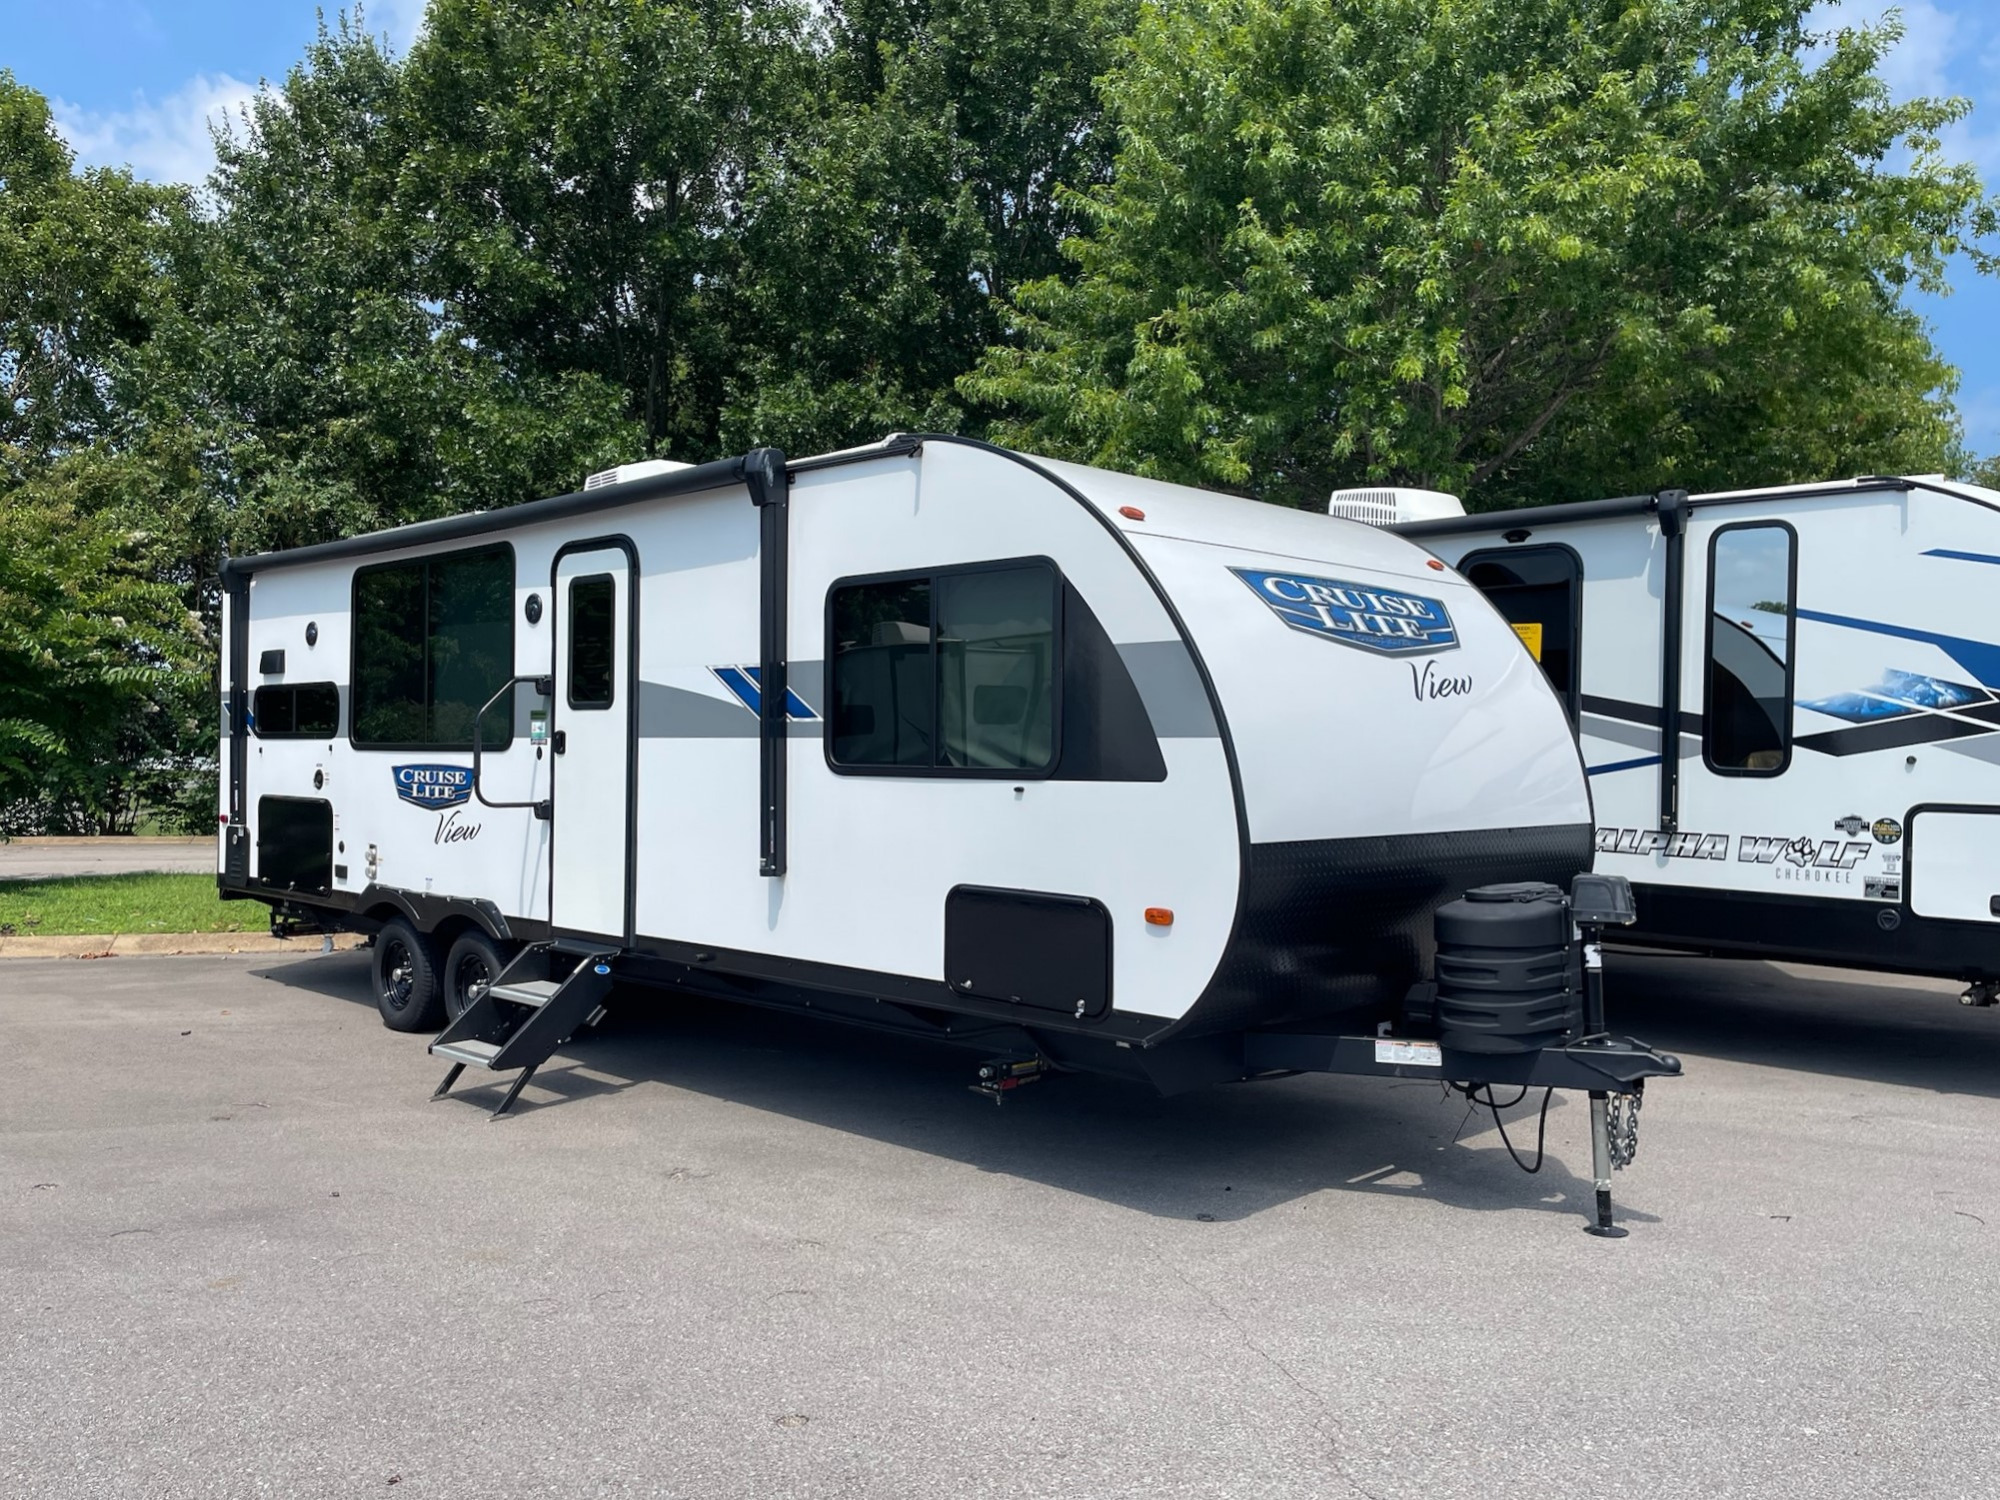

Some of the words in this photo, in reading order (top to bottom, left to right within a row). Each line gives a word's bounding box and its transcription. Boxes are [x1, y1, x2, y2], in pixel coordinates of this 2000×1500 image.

[1263, 577, 1435, 619] CRUISE
[1309, 604, 1429, 640] LITE
[1404, 659, 1472, 702] View
[399, 769, 466, 785] CRUISE
[411, 784, 456, 799] LITE
[434, 810, 481, 845] View
[1595, 828, 1729, 860] ALPHA
[1776, 867, 1851, 884] CHEROKEE
